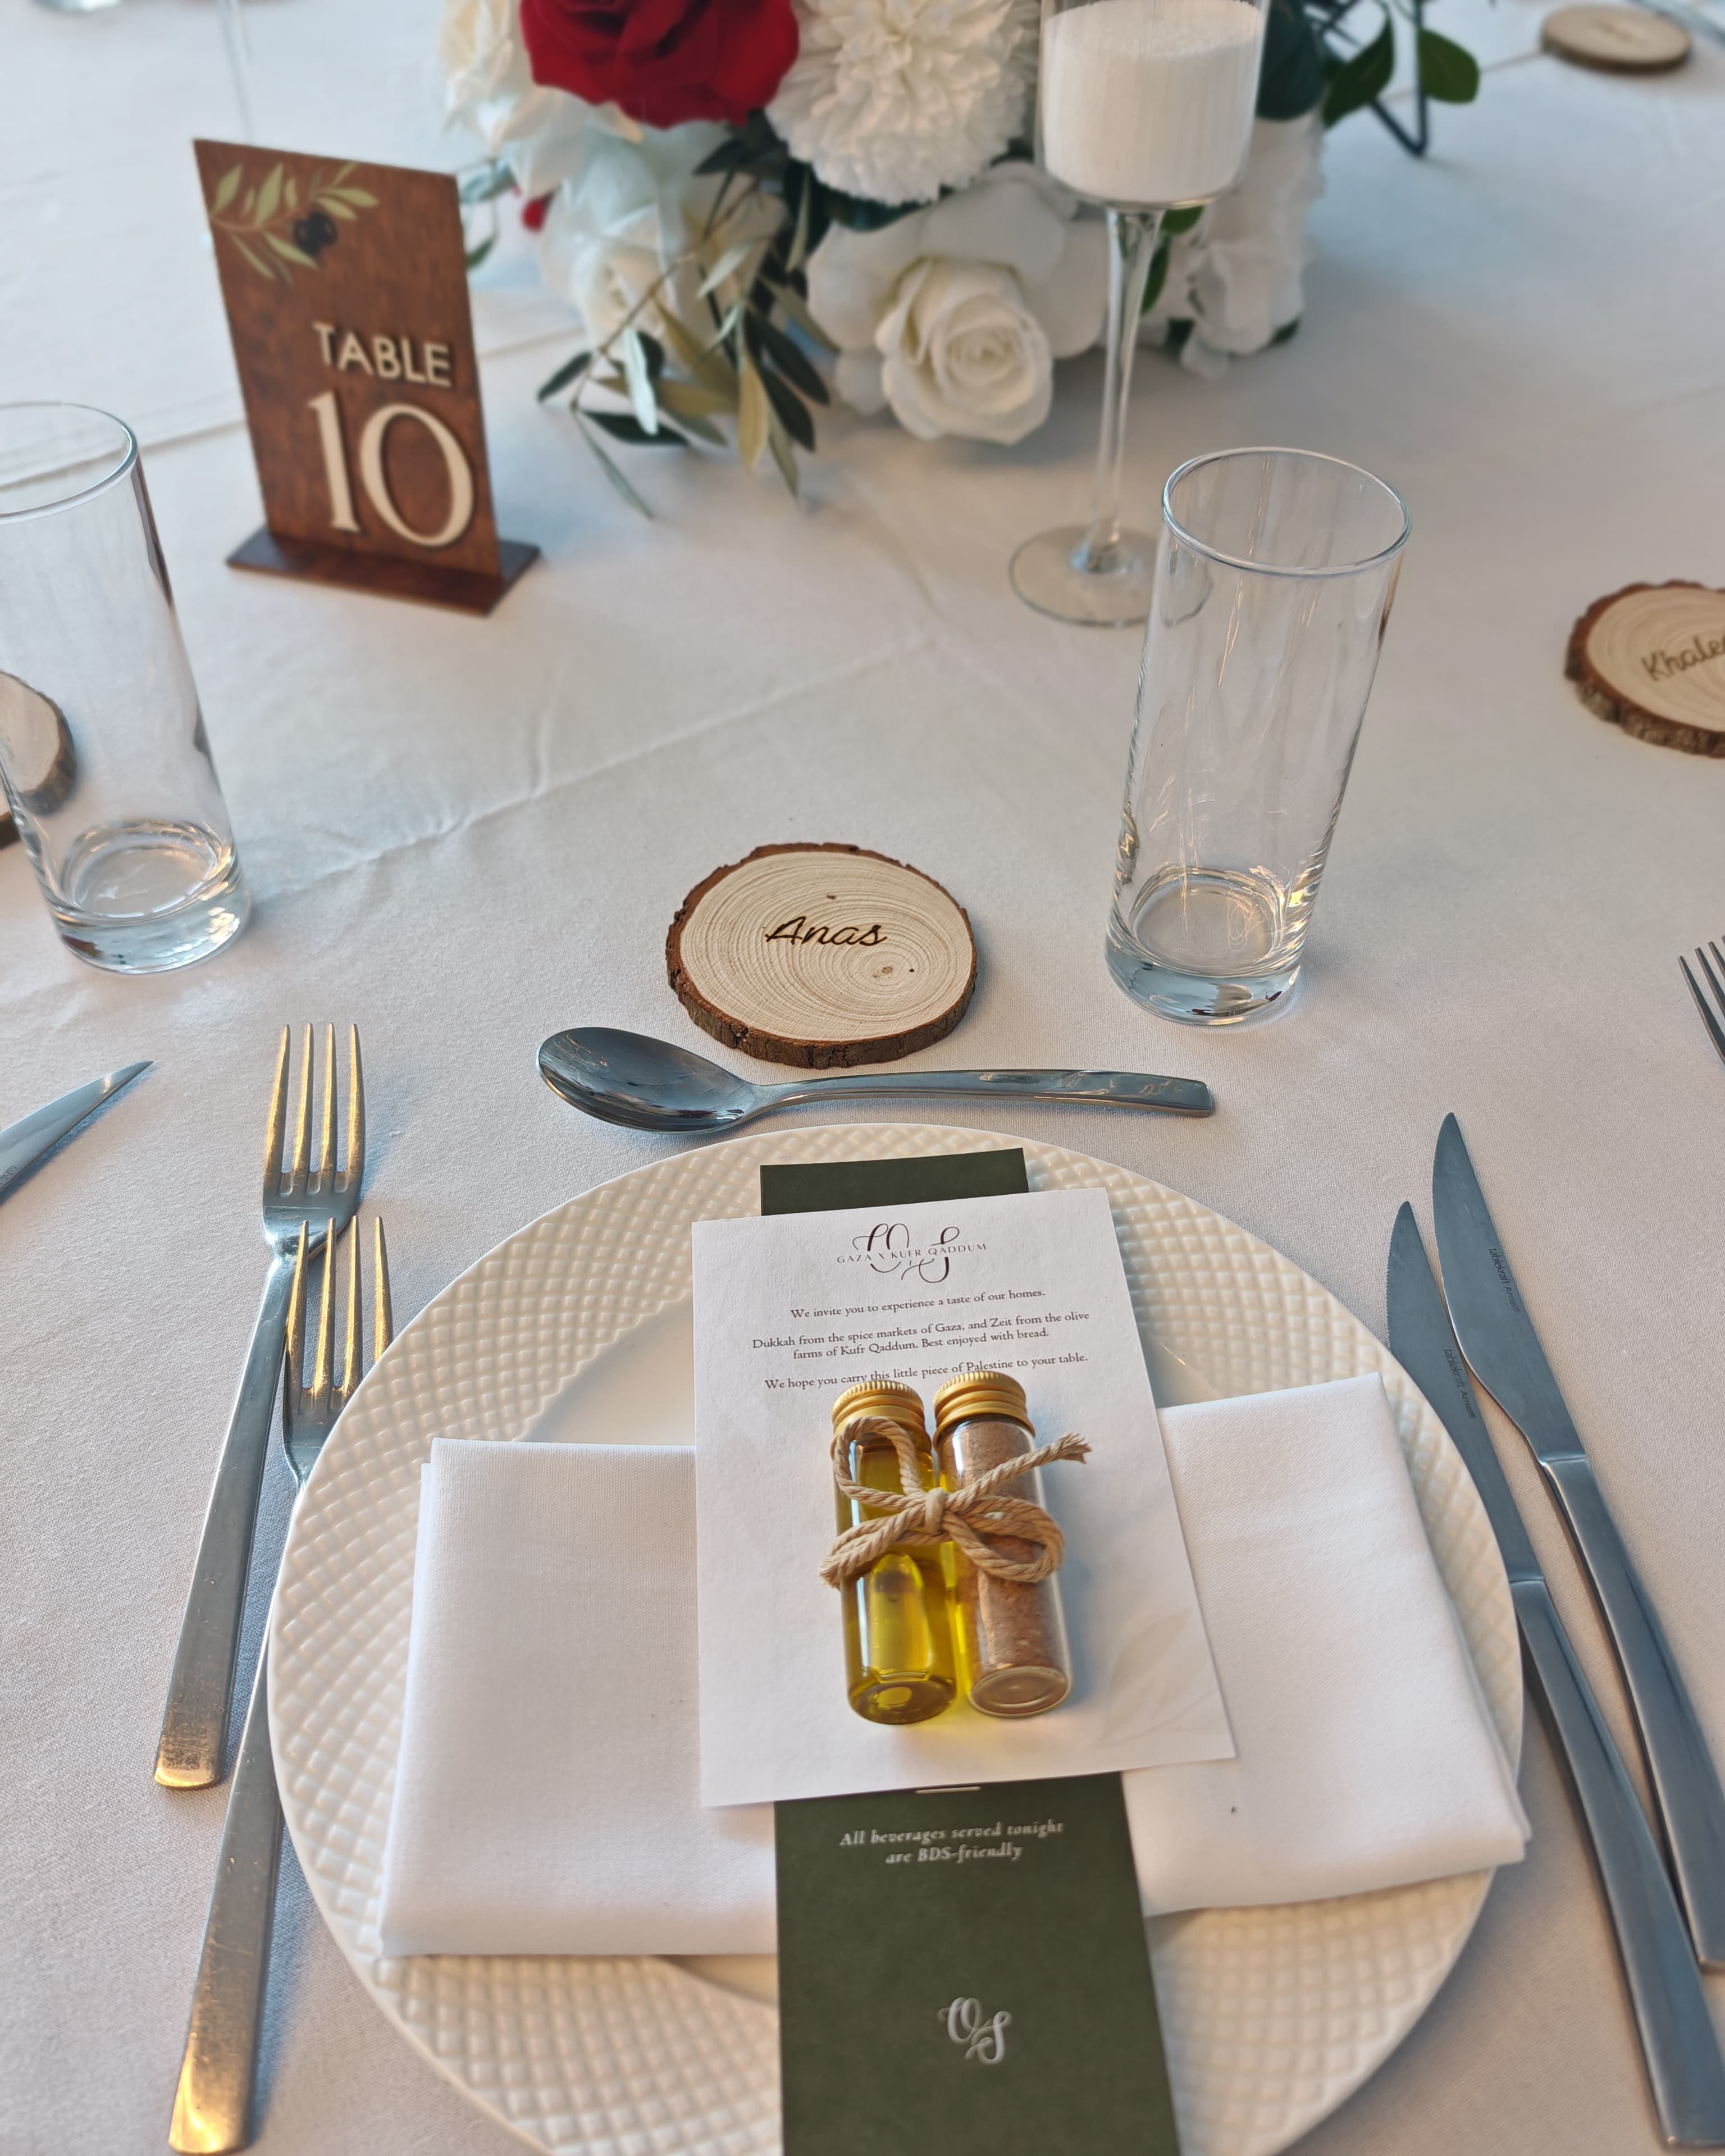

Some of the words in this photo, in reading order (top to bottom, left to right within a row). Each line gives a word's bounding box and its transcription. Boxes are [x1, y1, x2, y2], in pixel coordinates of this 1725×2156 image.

[312, 321, 452, 387] TABLE
[307, 390, 474, 547] 10
[1641, 634, 1725, 682] Khale
[764, 916, 888, 947] Anas
[837, 1254, 871, 1263] GAZA
[891, 1249, 921, 1259] KUFR
[928, 1243, 987, 1256] QADDUM
[790, 1308, 810, 1318] We
[813, 1308, 842, 1317] invite
[845, 1307, 865, 1317] you
[881, 1299, 935, 1313] experience
[973, 1291, 986, 1302] of
[1008, 1289, 1046, 1299] homes.
[752, 1336, 796, 1349] Dukkah
[799, 1335, 825, 1345] from
[828, 1332, 845, 1342] the
[847, 1331, 874, 1344] spice
[876, 1327, 918, 1339] markets
[920, 1323, 933, 1334] of
[934, 1323, 965, 1332] Gaza,
[968, 1318, 988, 1330] and
[989, 1317, 1012, 1327] Zeit
[1015, 1315, 1043, 1325] from
[1044, 1312, 1062, 1323] the
[1064, 1311, 1089, 1321] olive
[793, 1349, 823, 1359] farms
[825, 1346, 839, 1356] of
[839, 1344, 865, 1355] Kufr
[868, 1340, 919, 1354] Qaddum.
[920, 1338, 944, 1348] Best
[946, 1332, 987, 1347] enjoyed
[990, 1330, 1014, 1341] with
[1016, 1327, 1049, 1339] bread.
[764, 1379, 785, 1390] We
[787, 1377, 815, 1390] hope
[817, 1378, 838, 1389] you
[841, 1374, 868, 1383] carry
[870, 1370, 890, 1381] this
[893, 1367, 918, 1378] little
[921, 1365, 948, 1380] piece
[951, 1362, 964, 1373] of
[965, 1359, 1014, 1371] Palestine
[1031, 1358, 1056, 1369] your
[1058, 1352, 1088, 1363] table.
[839, 1830, 865, 1846] All
[870, 1829, 946, 1845] beverages
[951, 1822, 1002, 1838] served
[1007, 1819, 1064, 1838] tonight
[886, 1853, 912, 1864] are
[917, 1842, 1023, 1864] BDS-friendly
